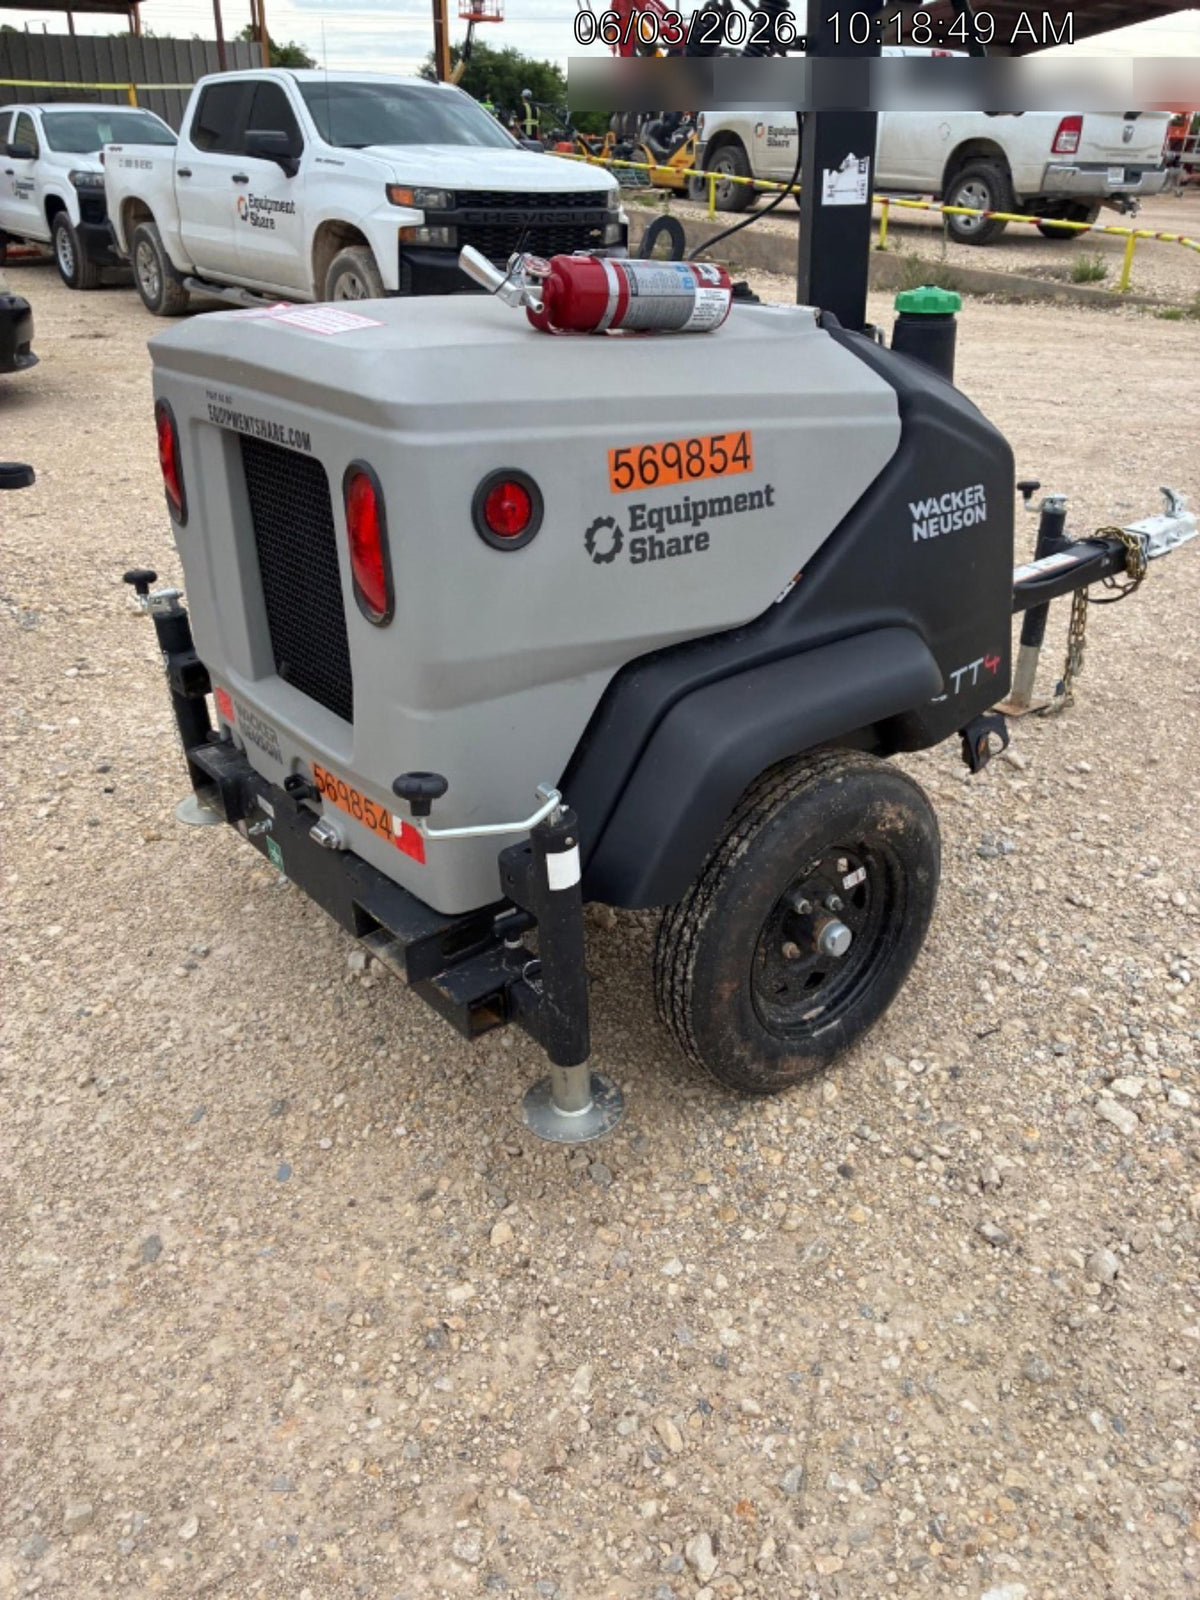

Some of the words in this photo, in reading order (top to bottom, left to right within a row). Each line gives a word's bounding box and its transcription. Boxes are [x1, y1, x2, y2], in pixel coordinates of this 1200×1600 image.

[767, 126, 798, 138] Equipm
[767, 137, 790, 148] Share
[248, 193, 296, 215] Equipment
[249, 213, 276, 230] Share
[464, 211, 605, 225] CHEVROLET
[207, 402, 312, 452] EQUIPMENTSHARE.COM
[613, 432, 751, 489] 569854
[628, 483, 775, 534] Equipment
[908, 483, 986, 522] WACKER
[911, 502, 987, 543] NEUSON
[629, 531, 710, 565] Share
[313, 763, 393, 838] 569854
